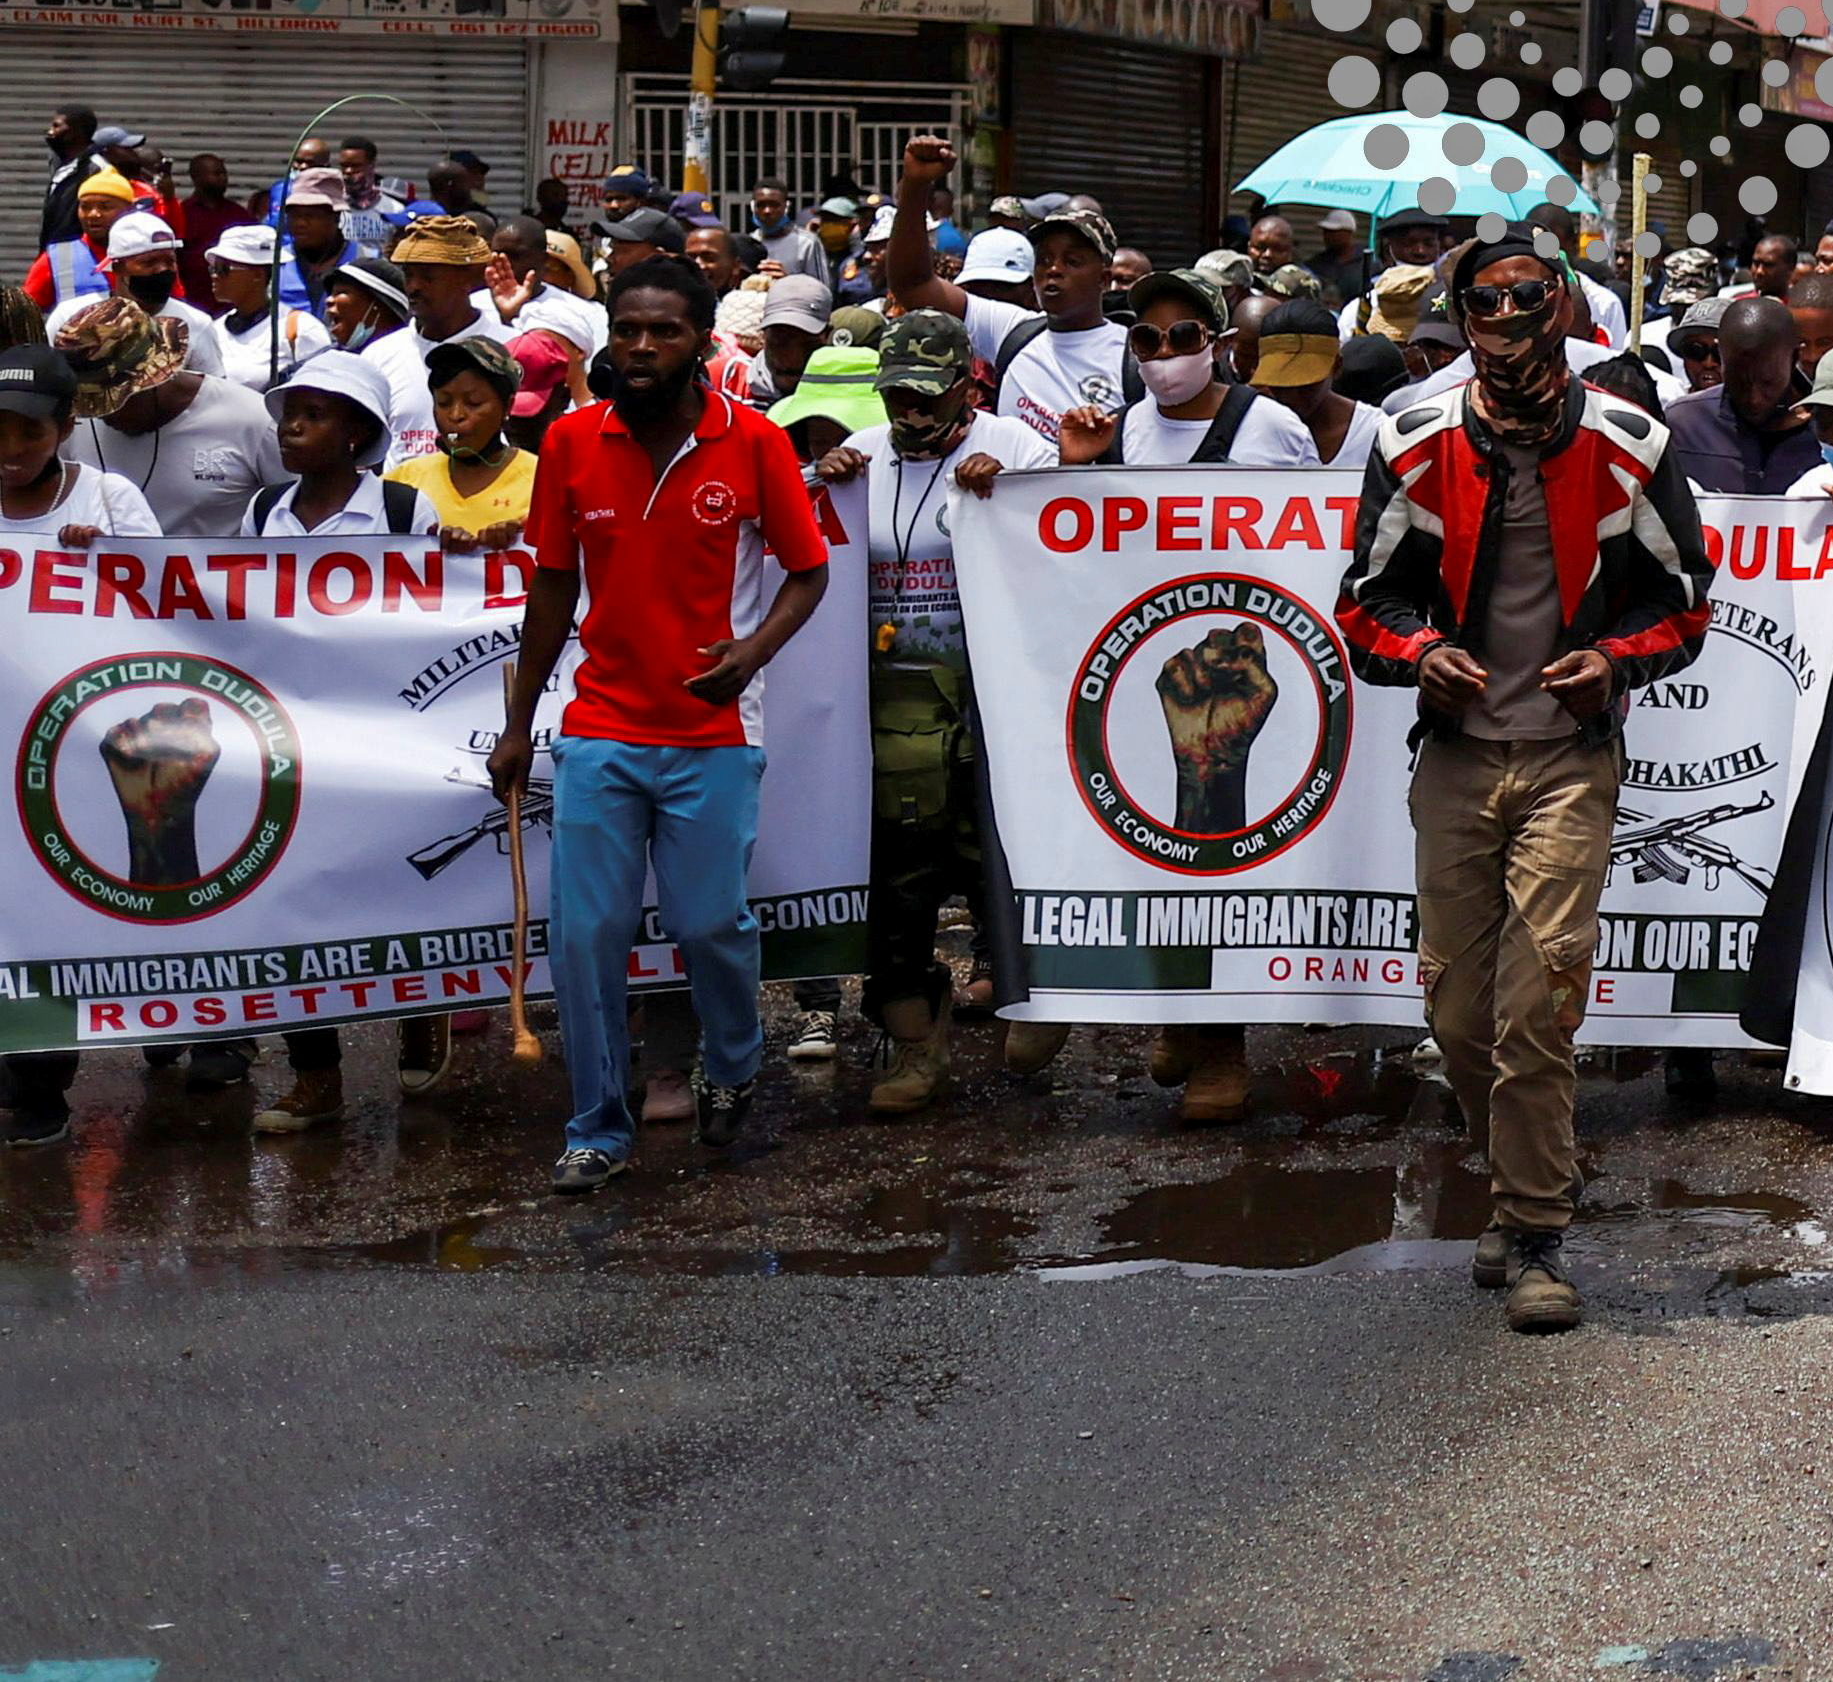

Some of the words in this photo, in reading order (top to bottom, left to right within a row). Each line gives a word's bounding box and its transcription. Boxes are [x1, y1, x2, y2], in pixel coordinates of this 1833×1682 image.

[236, 17, 340, 32] HILLBROW
[449, 22, 486, 35] 061
[547, 120, 610, 146] MILK
[1079, 582, 1238, 704] OPERATION
[1245, 586, 1346, 704] DUDULA
[28, 661, 182, 791] OPERATION
[200, 667, 292, 779] DUDULA
[1636, 680, 1710, 711] AND
[1089, 771, 1117, 810] OUR
[1114, 810, 1200, 862] ECONOMY
[1232, 832, 1268, 859] OUR
[1271, 767, 1333, 836] HERITAGE
[43, 832, 71, 868] OUR
[70, 867, 154, 911] ECONOMY
[188, 881, 224, 907] OUR
[227, 819, 280, 886] HERITAGE
[51, 951, 287, 997] IMMIGRANTS
[299, 944, 378, 977] ARE
[385, 940, 414, 972] A
[1135, 895, 1350, 947] IMMIGRANTS
[1350, 899, 1412, 948] ARE
[1642, 920, 1710, 971] OUR
